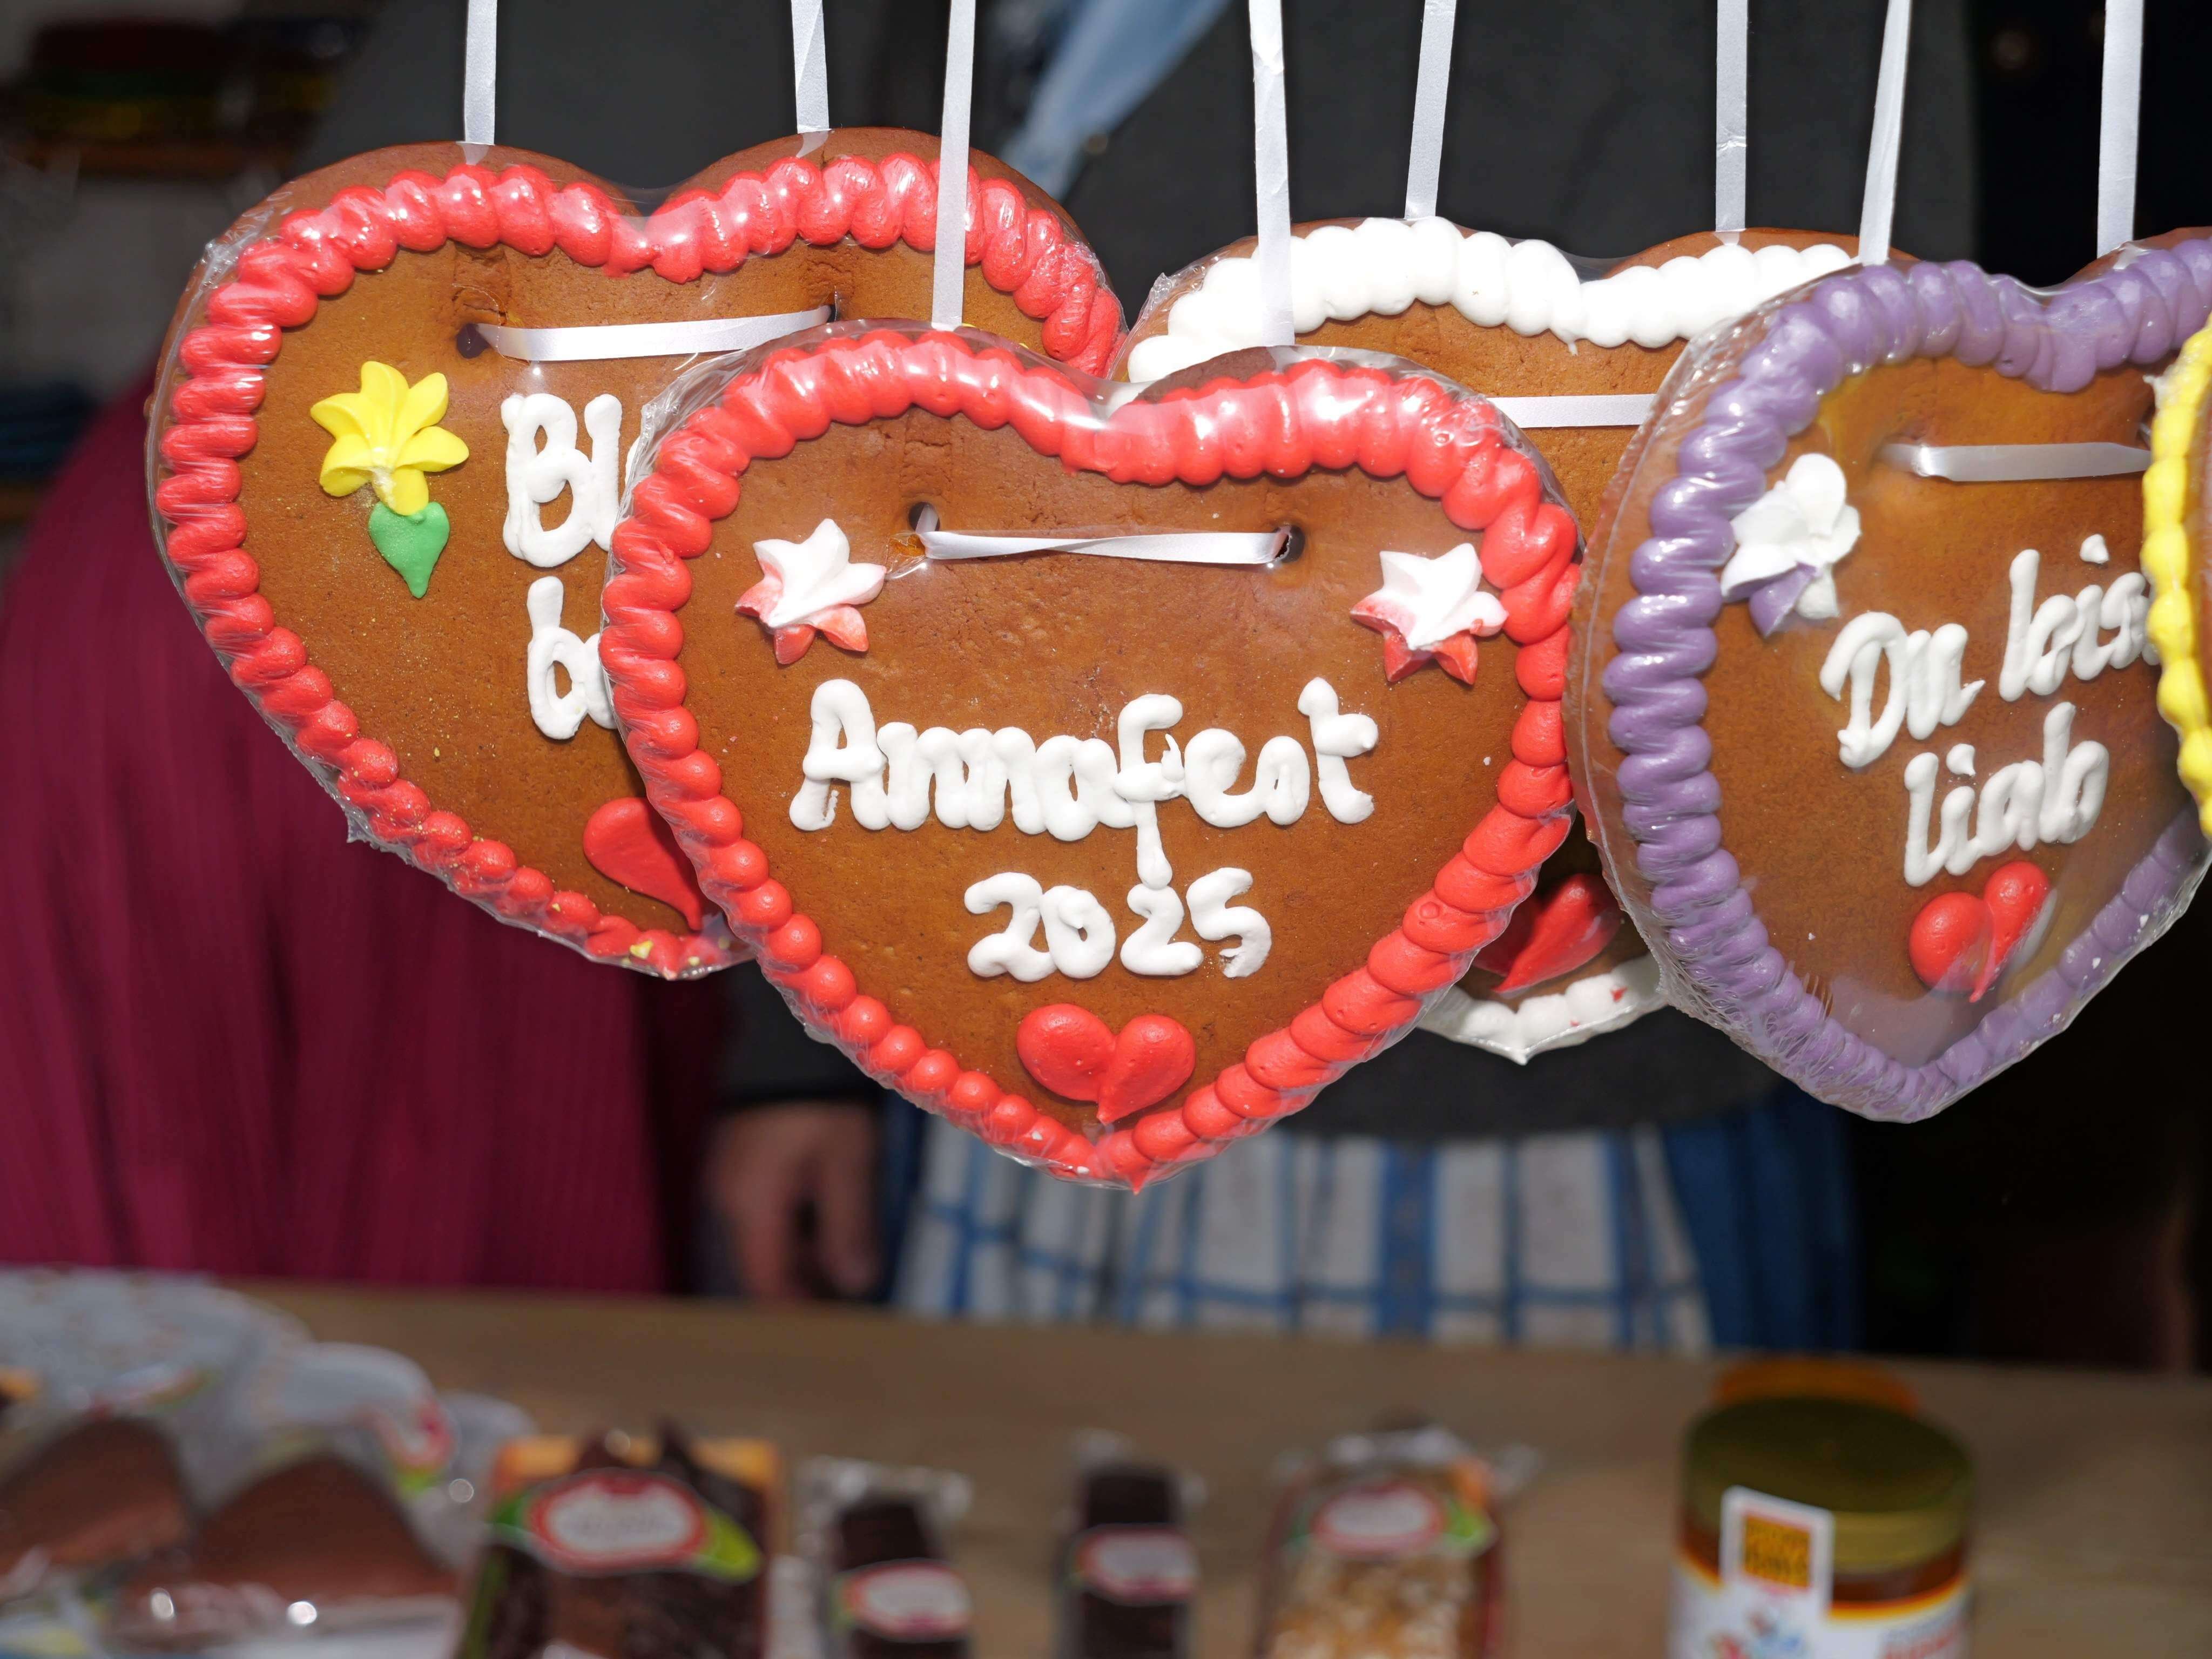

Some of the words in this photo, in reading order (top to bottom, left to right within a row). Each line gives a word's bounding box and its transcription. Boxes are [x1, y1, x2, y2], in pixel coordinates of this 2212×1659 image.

[501, 393, 640, 567] Bl
[1820, 611, 1986, 768] Du
[1999, 534, 2160, 702] bis
[789, 677, 1379, 889] Annafest
[1904, 702, 2109, 887] liab
[964, 867, 1272, 981] 2025
